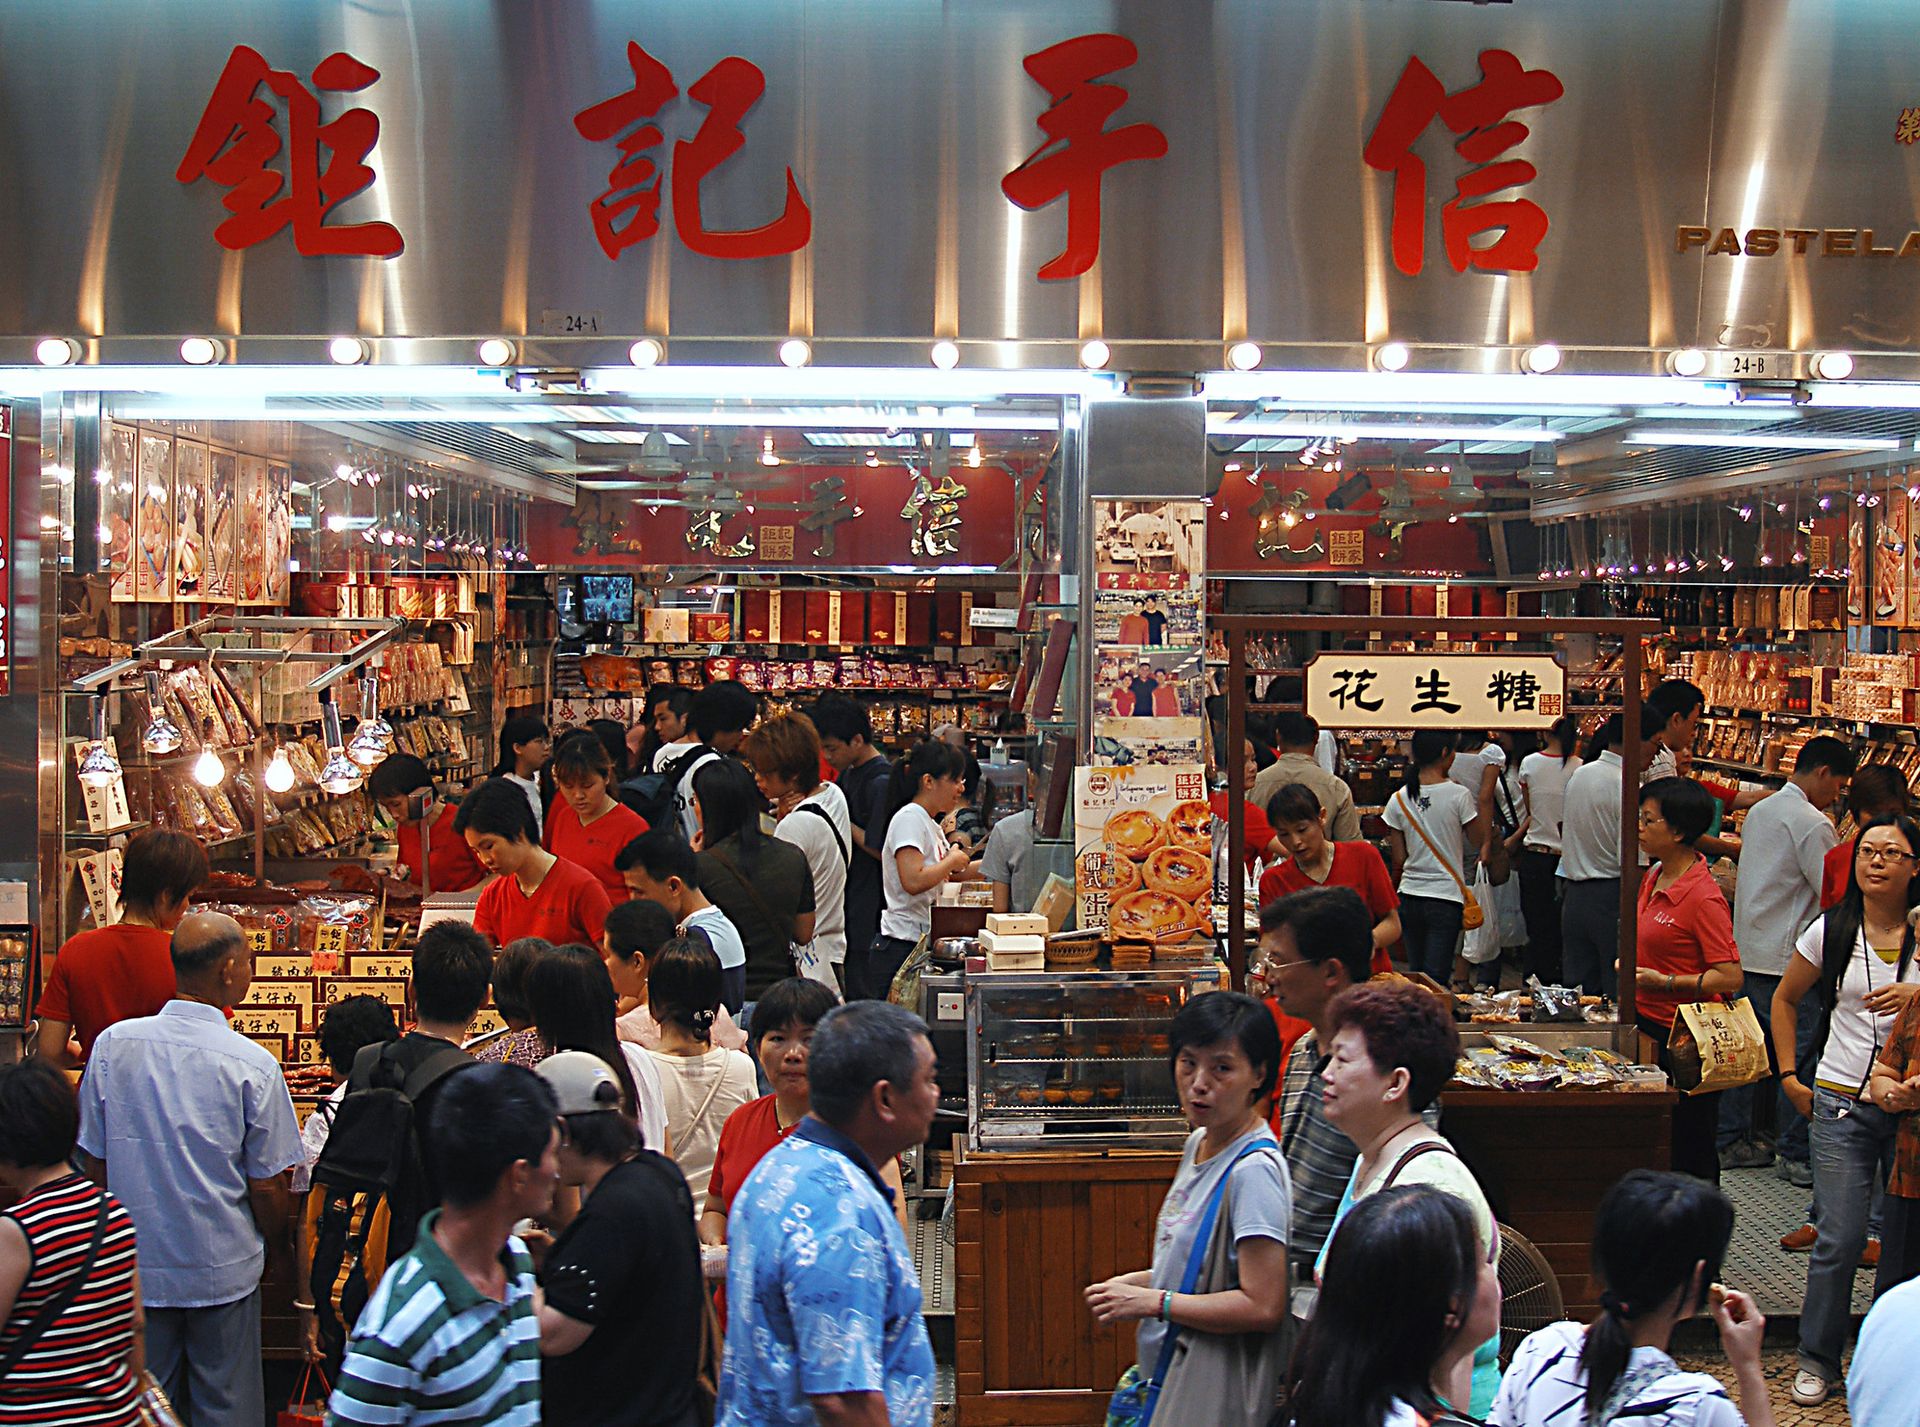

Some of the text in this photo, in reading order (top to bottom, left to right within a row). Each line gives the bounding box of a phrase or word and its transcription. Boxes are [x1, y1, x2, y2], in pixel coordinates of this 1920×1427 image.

[176, 33, 1564, 280] 鉅記手信
[1733, 357, 1765, 373] 24-B
[762, 527, 793, 541] 鉅記
[1332, 531, 1362, 545] 鉅記
[761, 544, 793, 560] 餅家
[1331, 549, 1363, 563] 餅家
[1329, 668, 1541, 714] 花生糖
[1177, 775, 1202, 786] 鉅記
[1177, 787, 1202, 799] 餅家
[252, 992, 296, 1004] 牛仔肉
